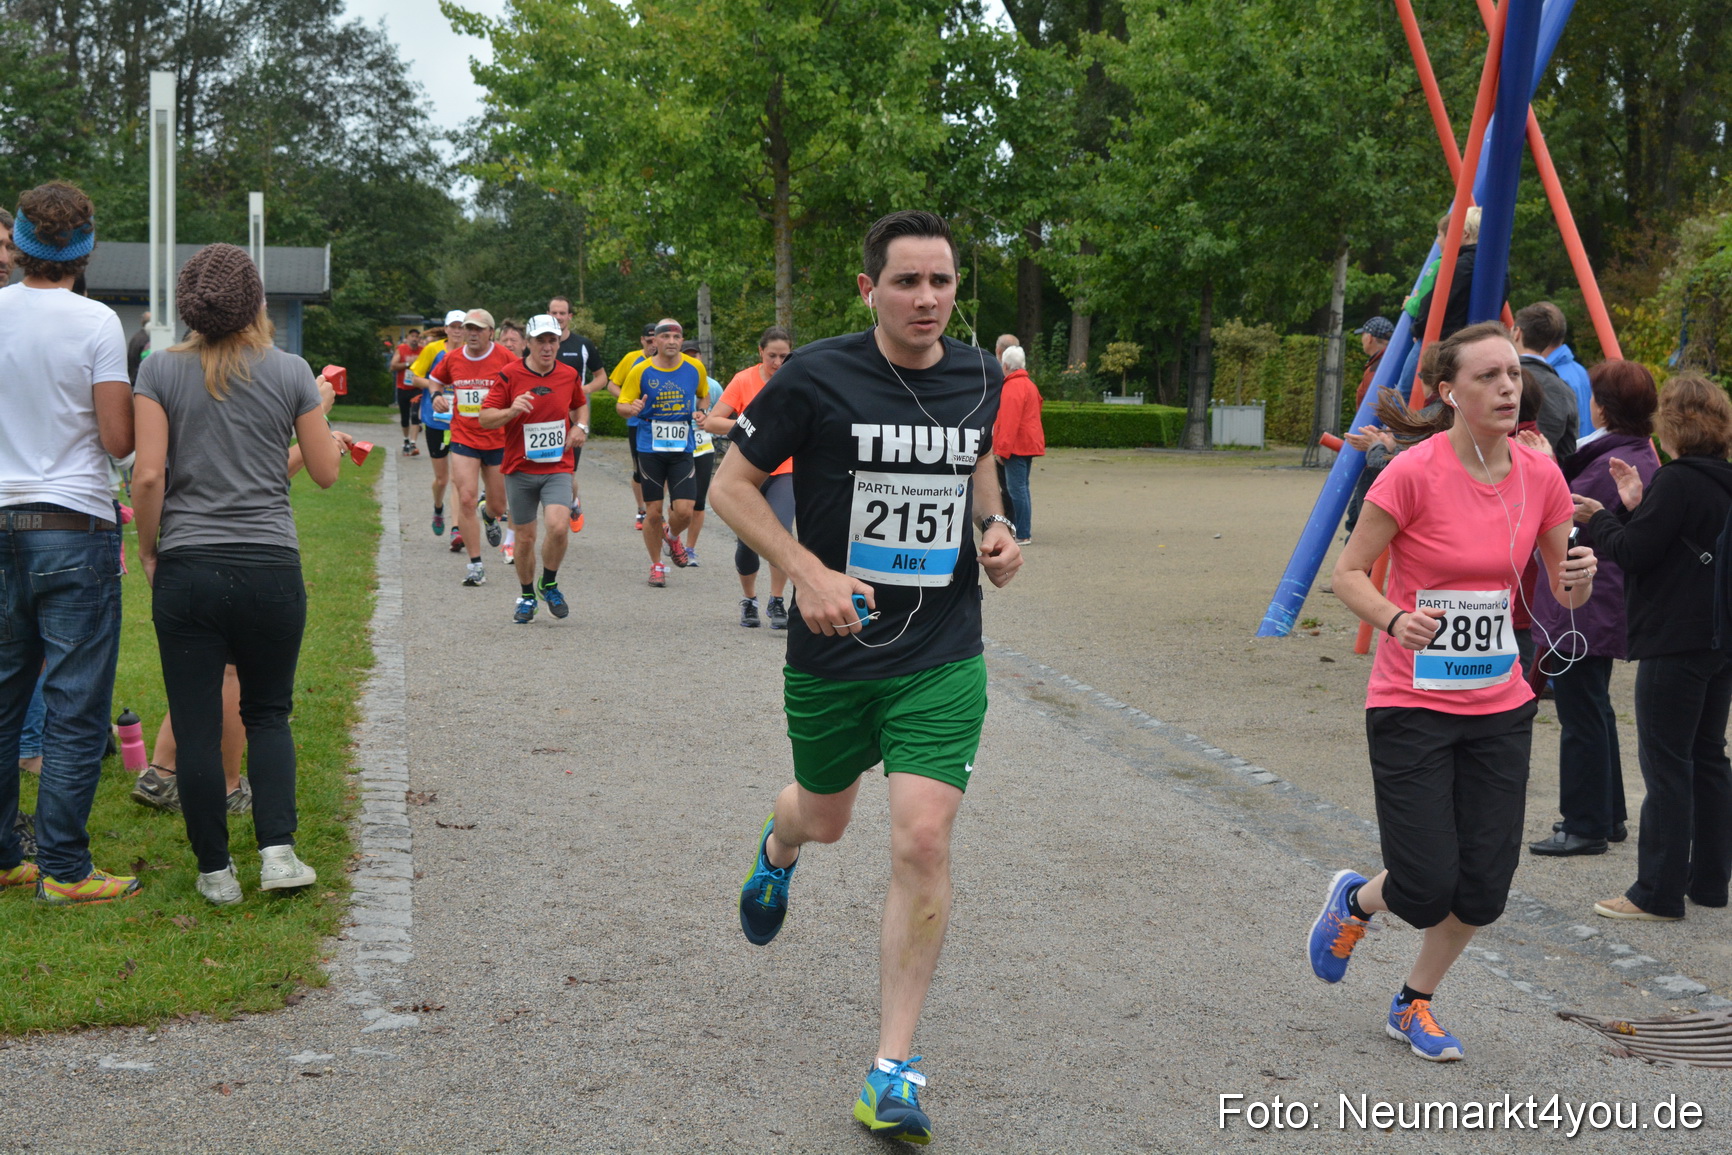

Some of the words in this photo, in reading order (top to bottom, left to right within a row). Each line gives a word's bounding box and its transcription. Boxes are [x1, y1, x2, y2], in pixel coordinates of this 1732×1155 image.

[465, 391, 479, 403] 18
[656, 426, 685, 439] 2106
[736, 412, 756, 438] HULE
[530, 431, 563, 448] 2288
[696, 433, 703, 444] 3
[851, 423, 980, 466] THULE
[857, 481, 898, 495] PARTL
[901, 486, 952, 497] Neumarkt
[863, 500, 955, 543] 2151
[892, 554, 927, 570] Alex
[1418, 599, 1455, 609] PARTL
[1458, 601, 1500, 610] Neumarkt
[1427, 615, 1504, 652] 2897
[1444, 661, 1492, 676] Yvonne
